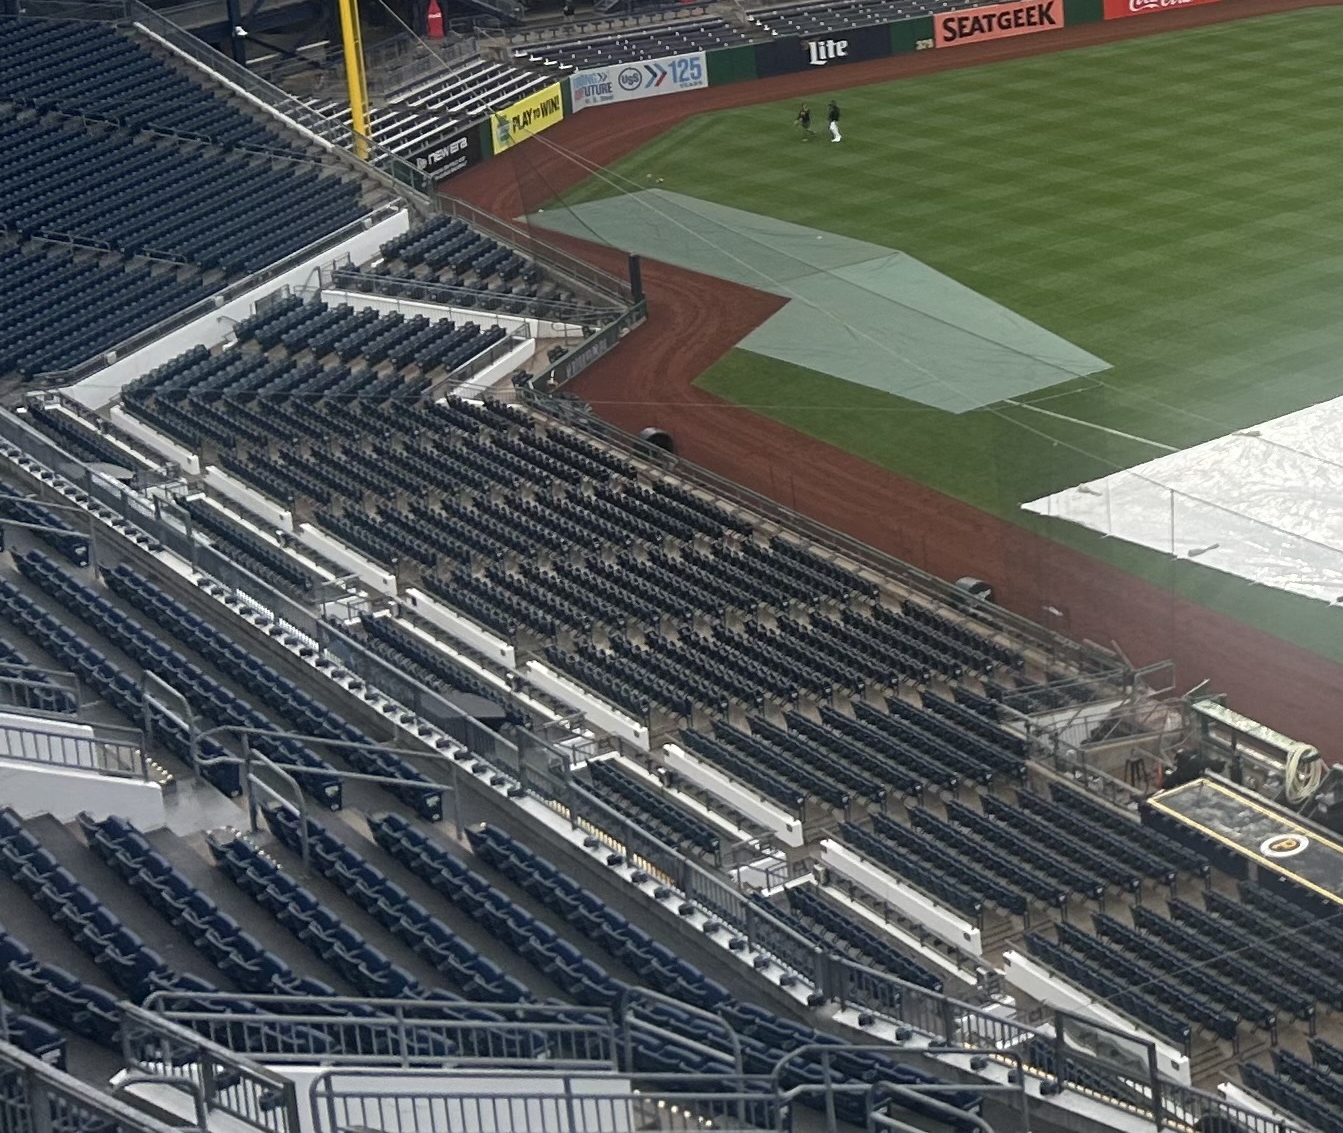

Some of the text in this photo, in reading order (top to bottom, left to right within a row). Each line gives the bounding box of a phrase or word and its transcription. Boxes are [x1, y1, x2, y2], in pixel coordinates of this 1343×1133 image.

[943, 0, 1056, 42] SEATGEEK
[808, 38, 848, 65] Lite
[669, 56, 702, 83] 125
[512, 110, 532, 134] PLAY
[540, 94, 560, 118] WIN!
